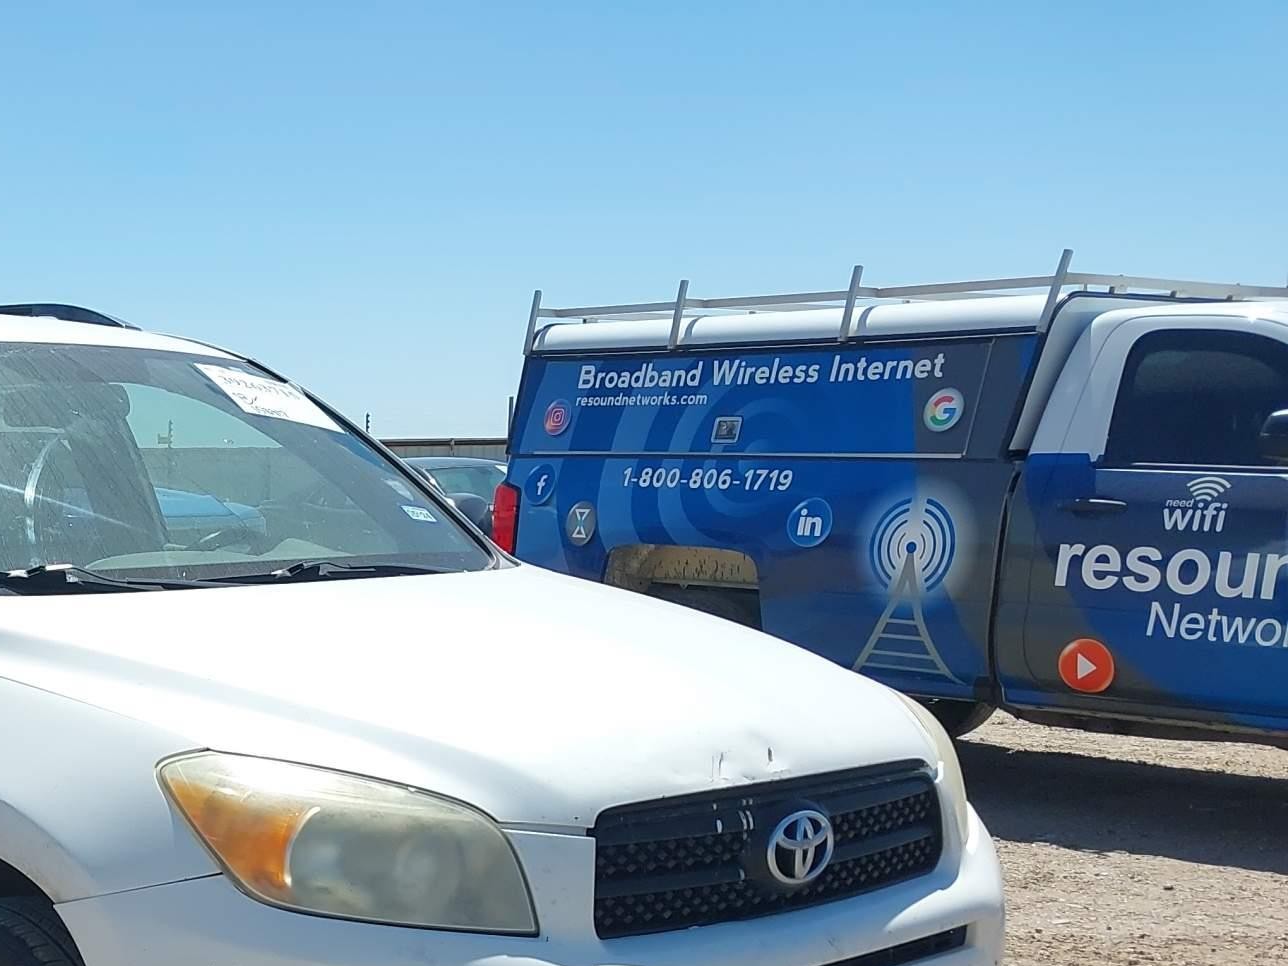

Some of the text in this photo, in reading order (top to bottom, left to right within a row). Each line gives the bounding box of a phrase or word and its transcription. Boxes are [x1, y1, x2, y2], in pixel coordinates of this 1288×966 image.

[577, 353, 945, 389] Broadband Wireless Internet
[575, 392, 708, 407] resoundnetworks.com
[623, 467, 793, 491] 1-800-806-1719
[1165, 499, 1195, 508] need
[796, 508, 823, 537] in
[1163, 502, 1228, 533] wifi
